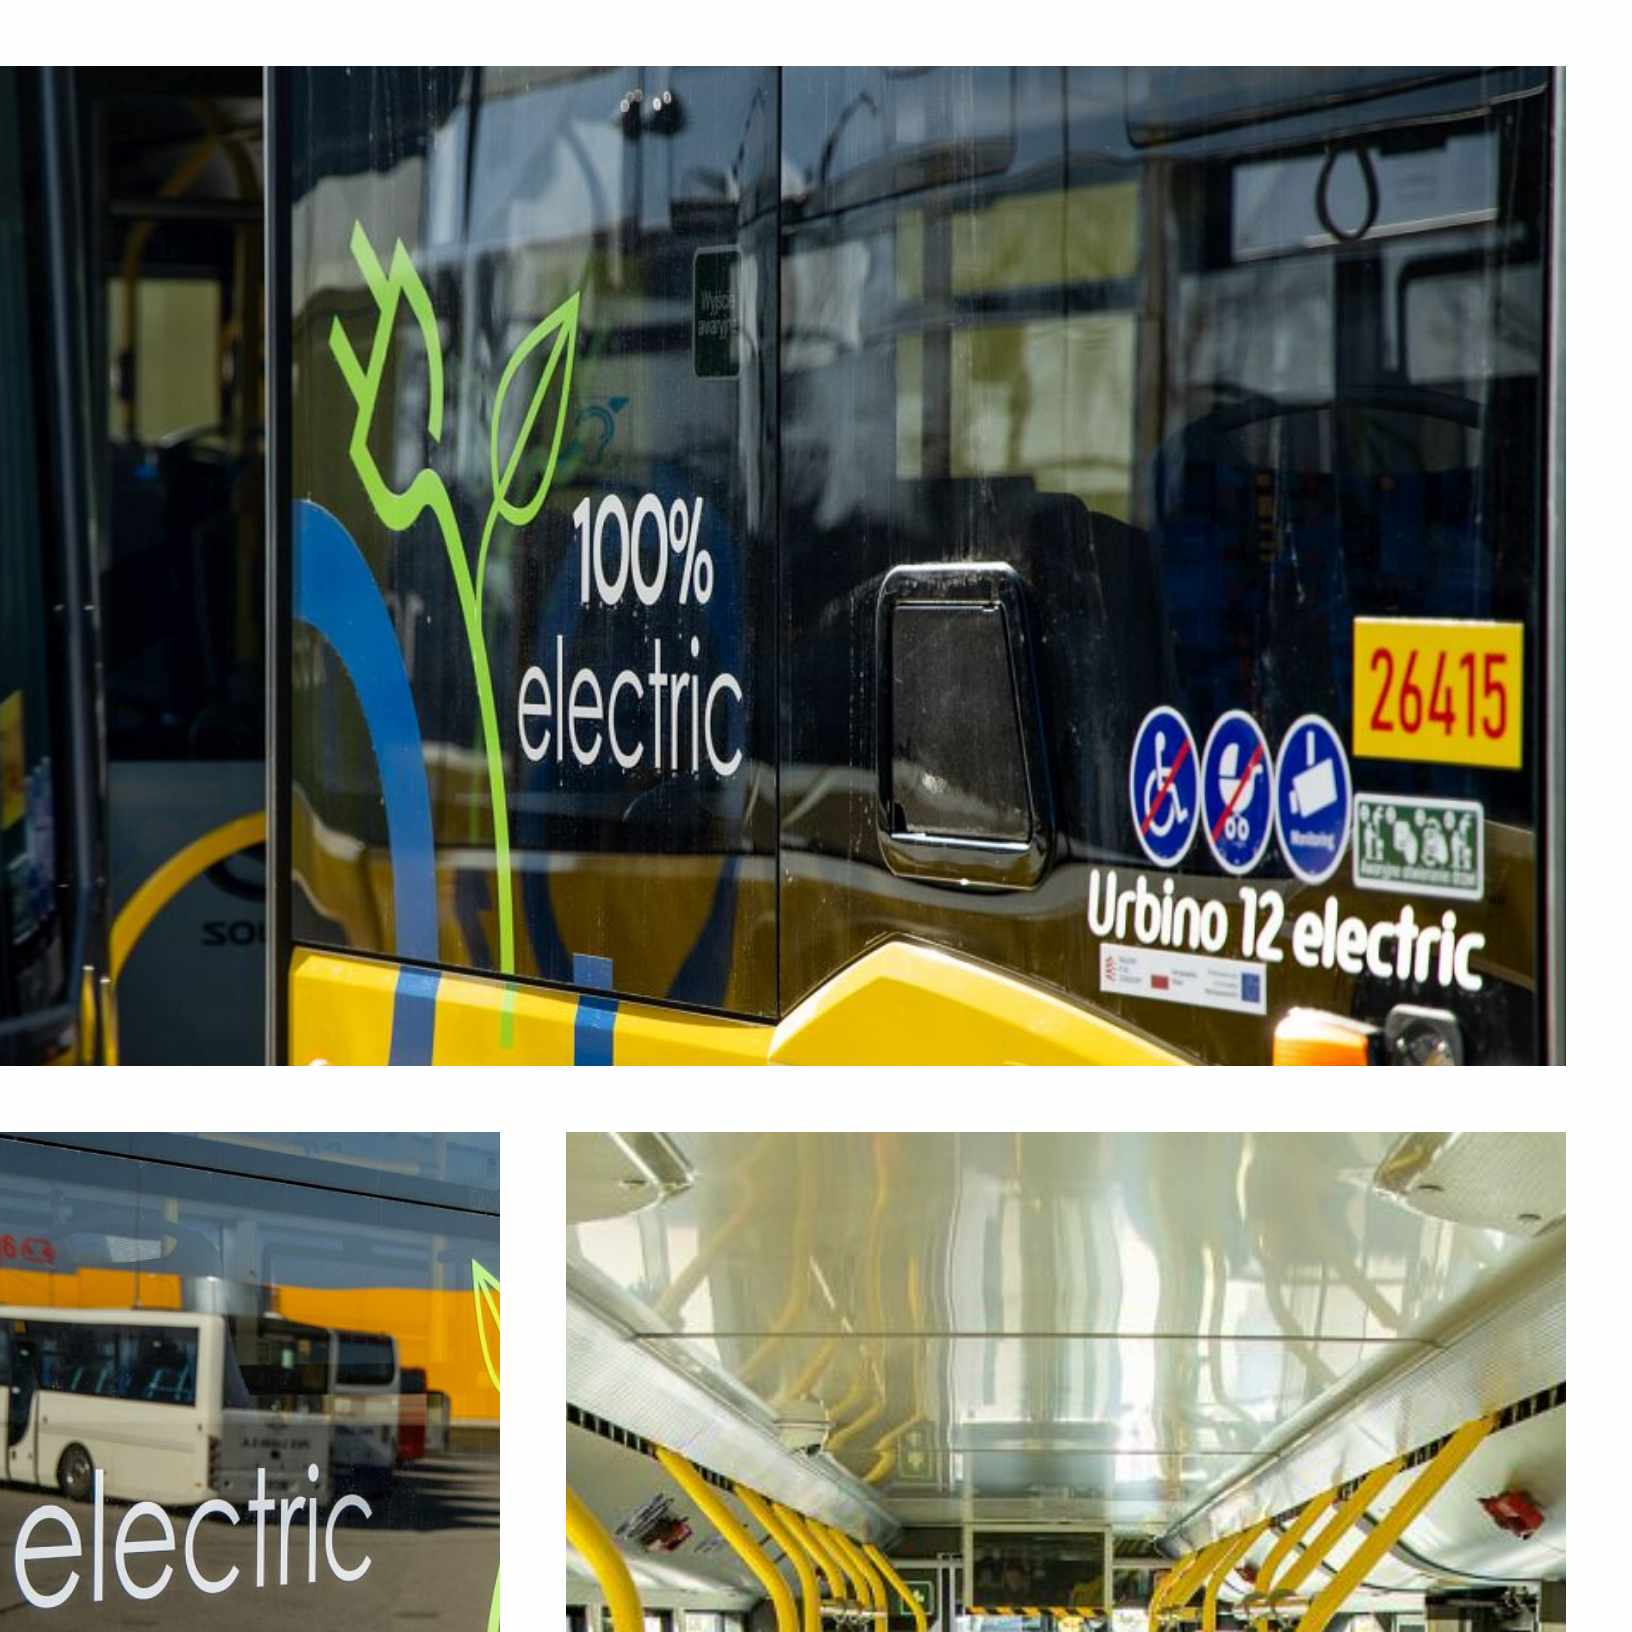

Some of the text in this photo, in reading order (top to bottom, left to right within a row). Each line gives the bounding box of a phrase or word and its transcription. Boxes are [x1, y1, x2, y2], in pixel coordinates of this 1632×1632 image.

[572, 493, 714, 605] 100%
[518, 634, 743, 776] electric
[1369, 647, 1508, 741] 26415
[1086, 867, 1486, 992] Urbino 12 electric
[14, 1463, 374, 1609] electric
